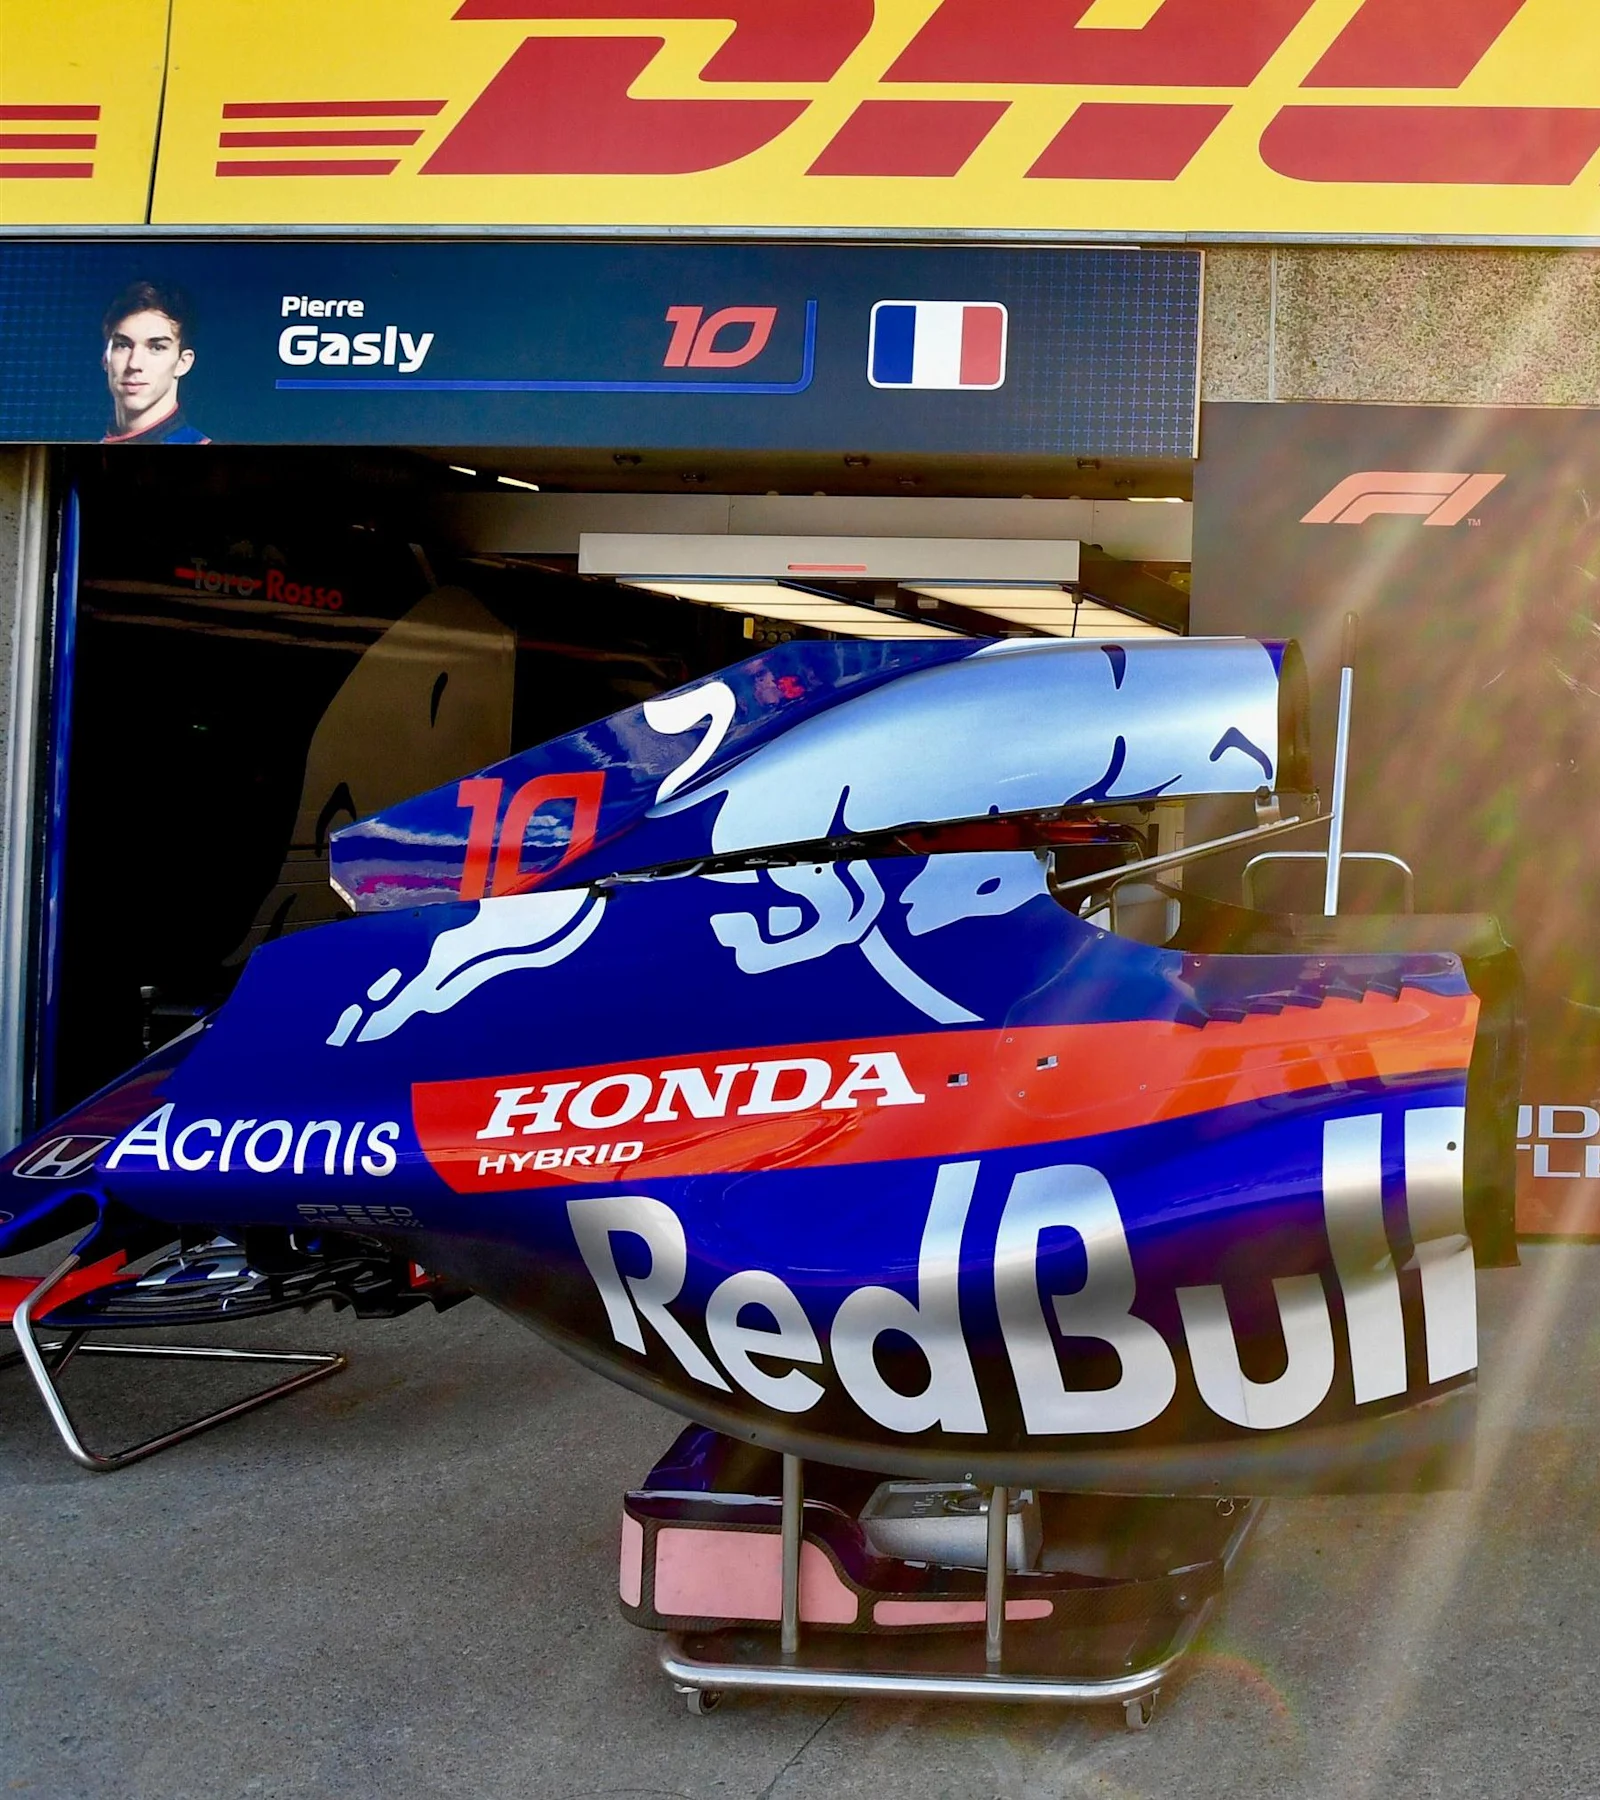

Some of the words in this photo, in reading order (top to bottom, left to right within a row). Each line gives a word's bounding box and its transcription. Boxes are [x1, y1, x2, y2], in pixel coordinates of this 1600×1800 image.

[280, 296, 365, 320] Pierre
[277, 324, 434, 374] Gasly
[663, 306, 777, 368] 10
[191, 557, 256, 597] Toro
[266, 569, 343, 610] Rosso
[456, 770, 607, 900] 10
[475, 1050, 926, 1142] HONDA
[105, 1102, 400, 1176] Acronis
[477, 1139, 645, 1176] HYBRID
